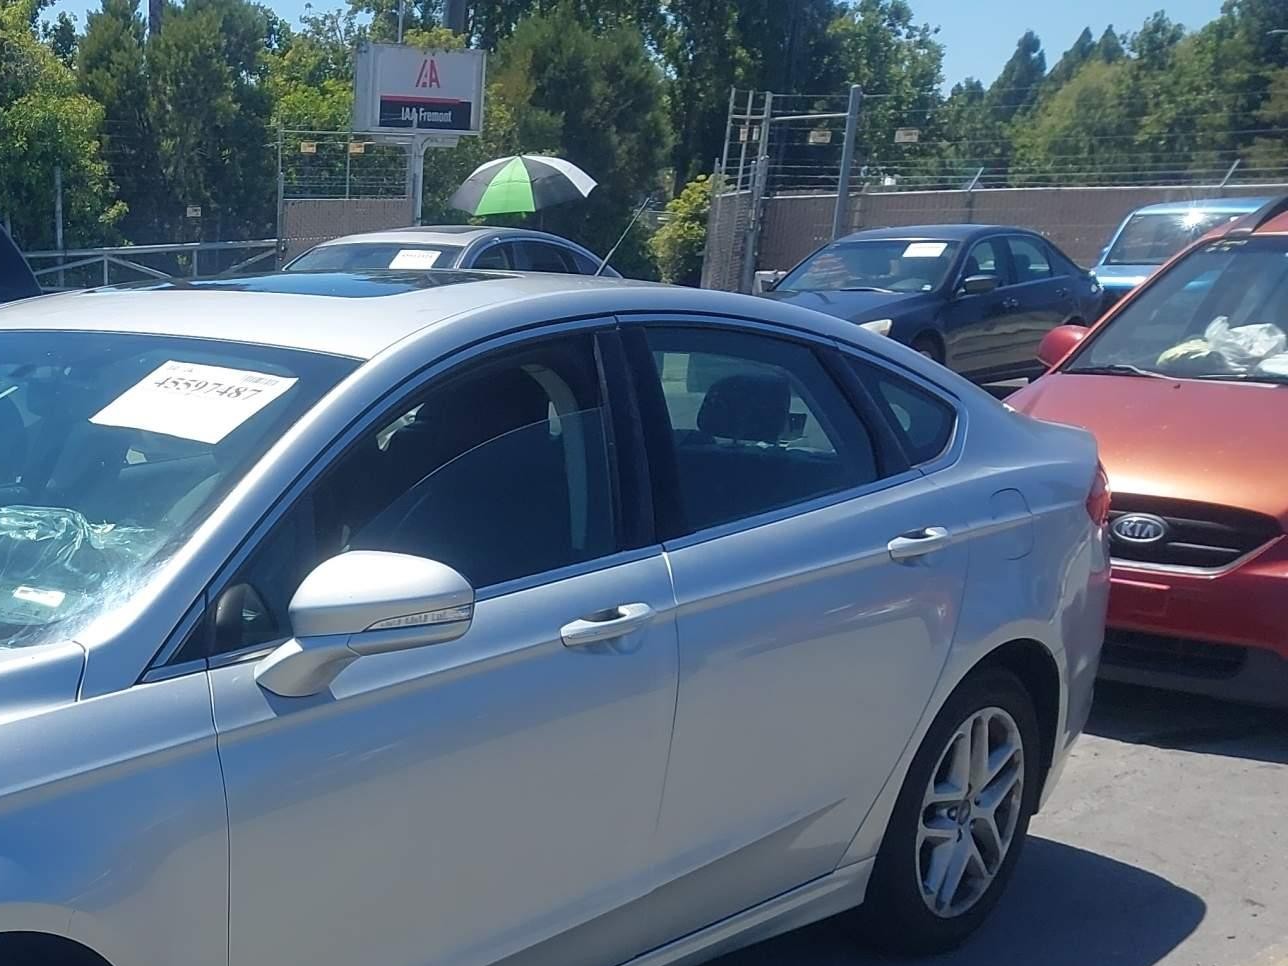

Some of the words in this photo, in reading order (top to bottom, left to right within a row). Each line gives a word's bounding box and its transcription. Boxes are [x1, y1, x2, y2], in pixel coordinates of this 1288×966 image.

[401, 107, 418, 121] IAA
[419, 107, 452, 123] Fremont
[154, 376, 263, 401] 45597487
[1120, 521, 1154, 538] KIA
